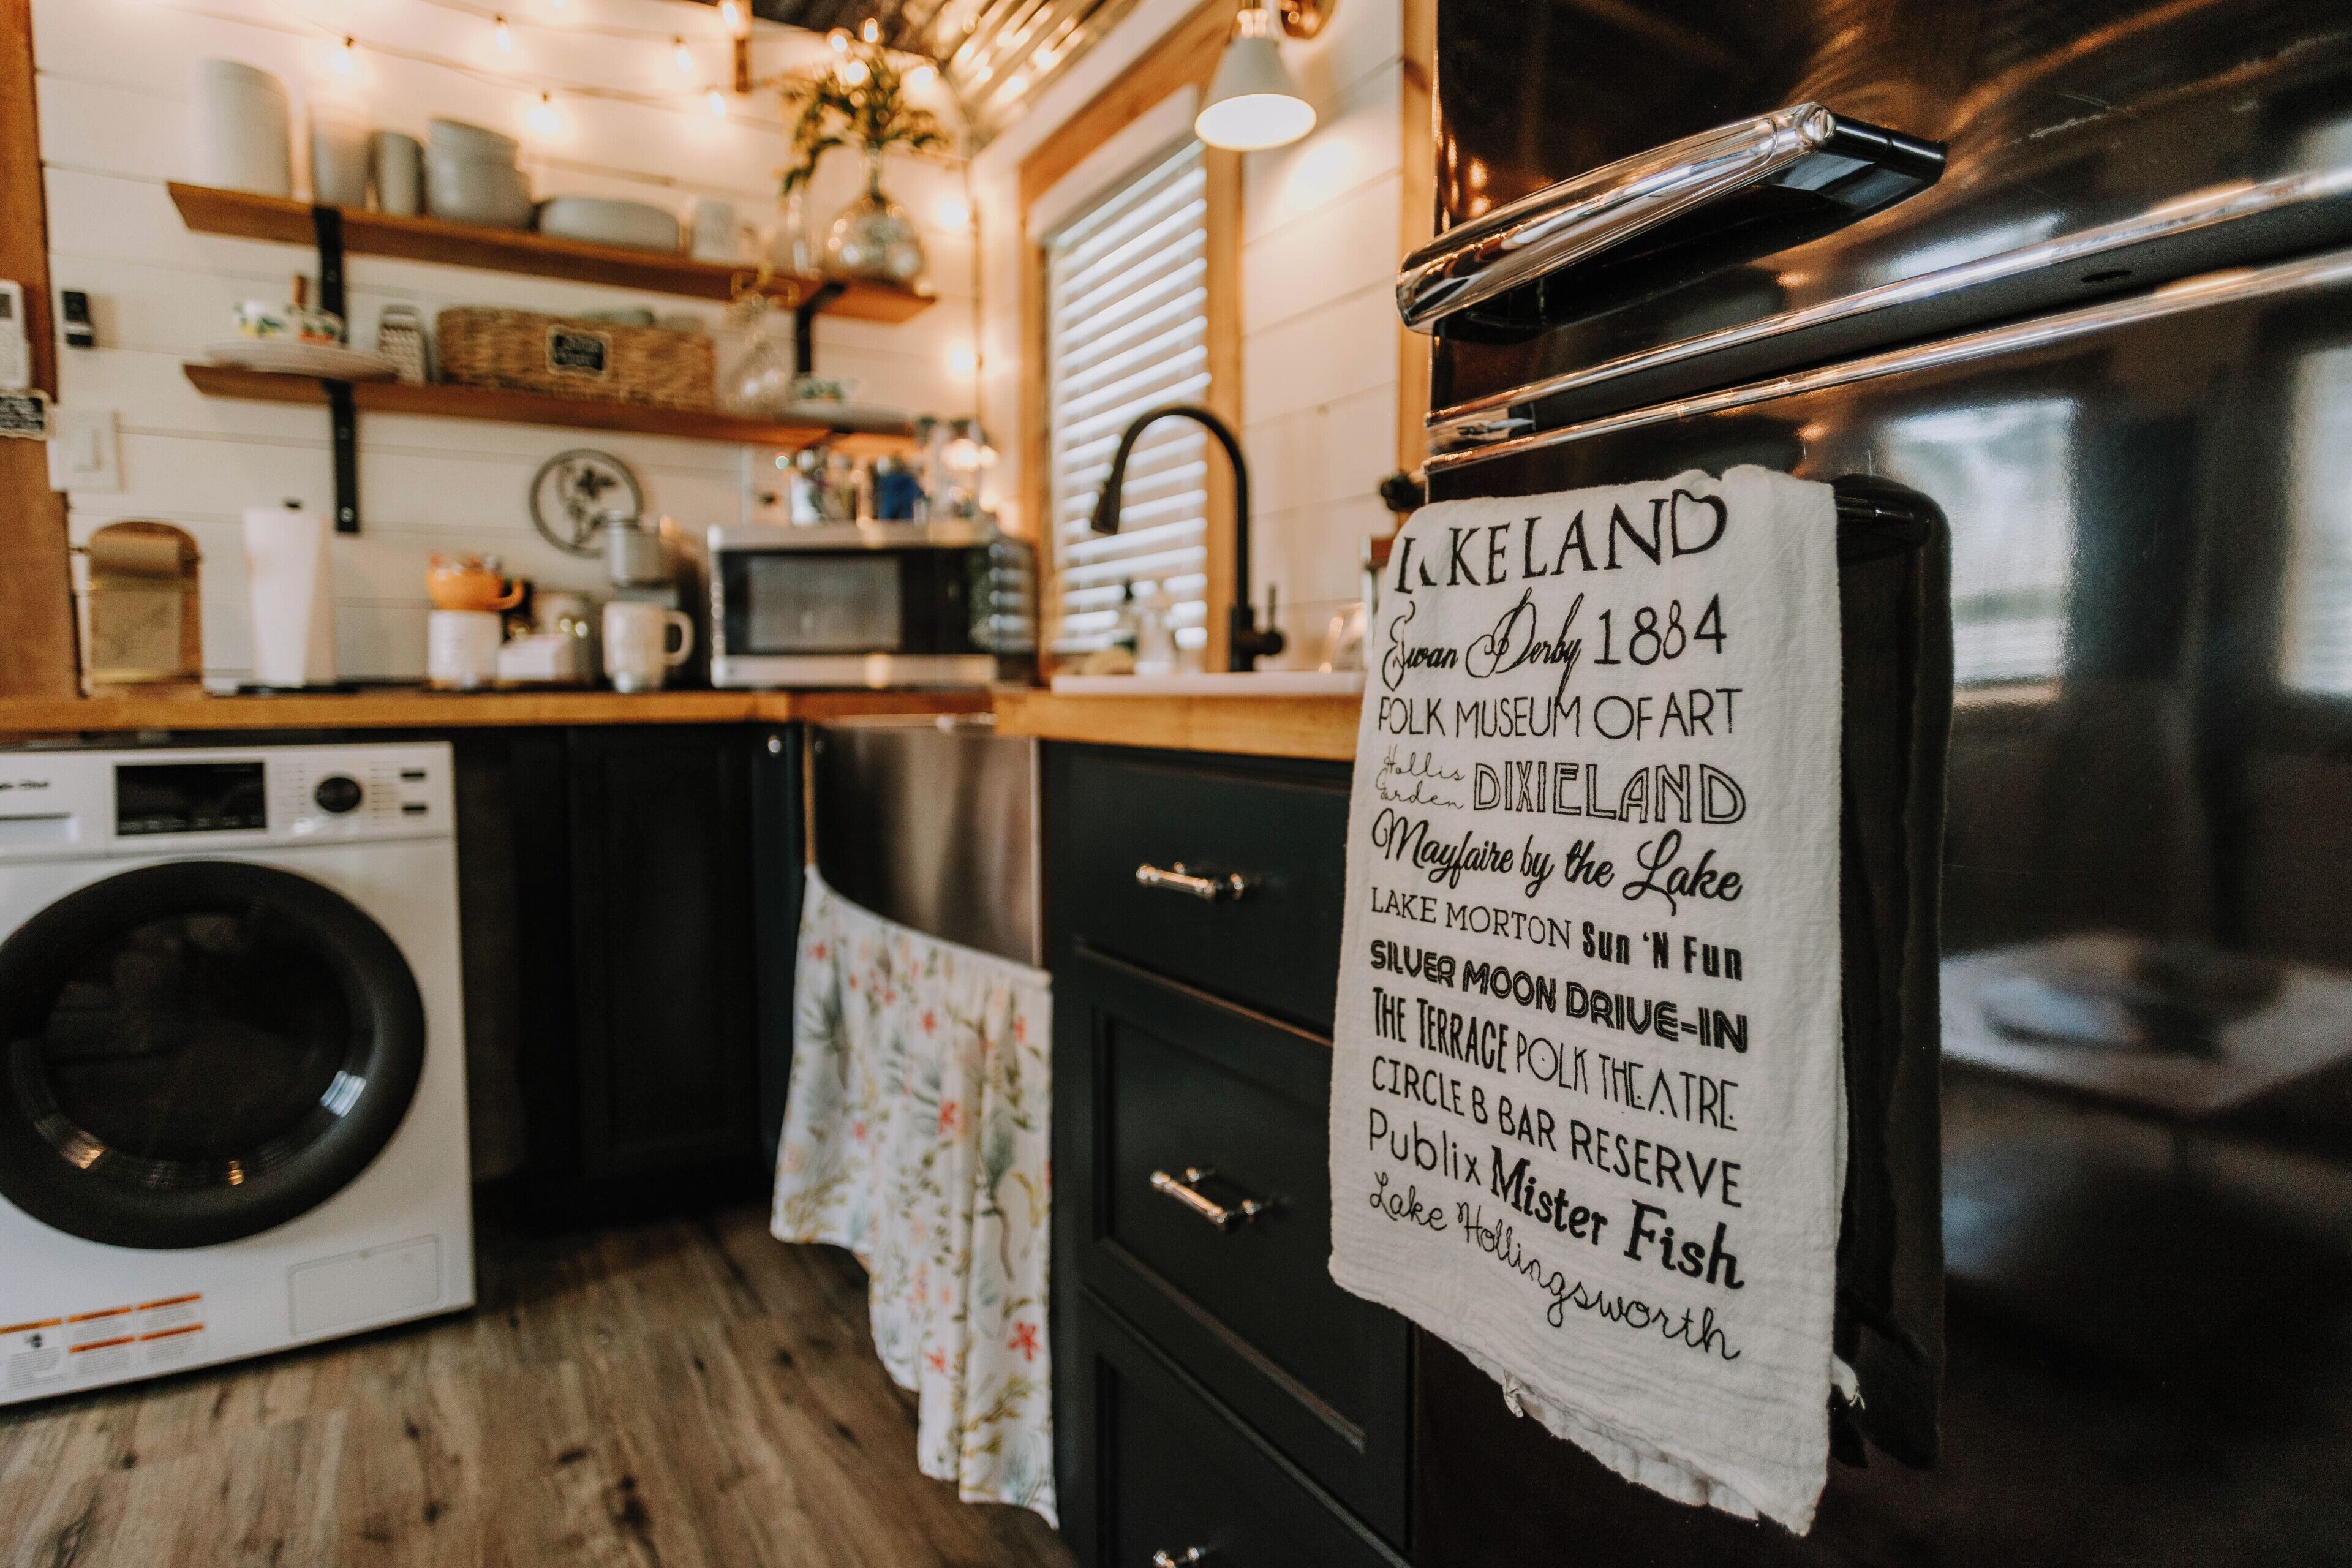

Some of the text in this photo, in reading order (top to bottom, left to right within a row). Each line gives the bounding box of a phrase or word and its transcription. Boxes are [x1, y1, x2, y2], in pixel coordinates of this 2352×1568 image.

[1466, 587, 1585, 704] Derby
[1594, 593, 1727, 665] 1884
[1378, 688, 1743, 740] POLK MUSEUM OF ART
[1383, 744, 1466, 780] Hollis
[1473, 761, 1746, 824] DIXIELAND
[1371, 808, 1743, 916] Mayfaire by the Lake
[1371, 887, 1571, 949] LAKE MORTON
[1583, 921, 1630, 965] Sun
[1684, 935, 1743, 981] Fun
[1370, 940, 1749, 1054] SILVER MOON DRIVE-IN
[1373, 987, 1509, 1073] THE TERRACE
[1516, 1031, 1740, 1131] POLK THEATRE
[1369, 1108, 1482, 1186] Publix
[1372, 1055, 1742, 1208] CIRCLE B BAR RESERVE
[1491, 1145, 1745, 1289] Mister Fish
[1369, 1171, 1741, 1360] Lake Hollingsworth
